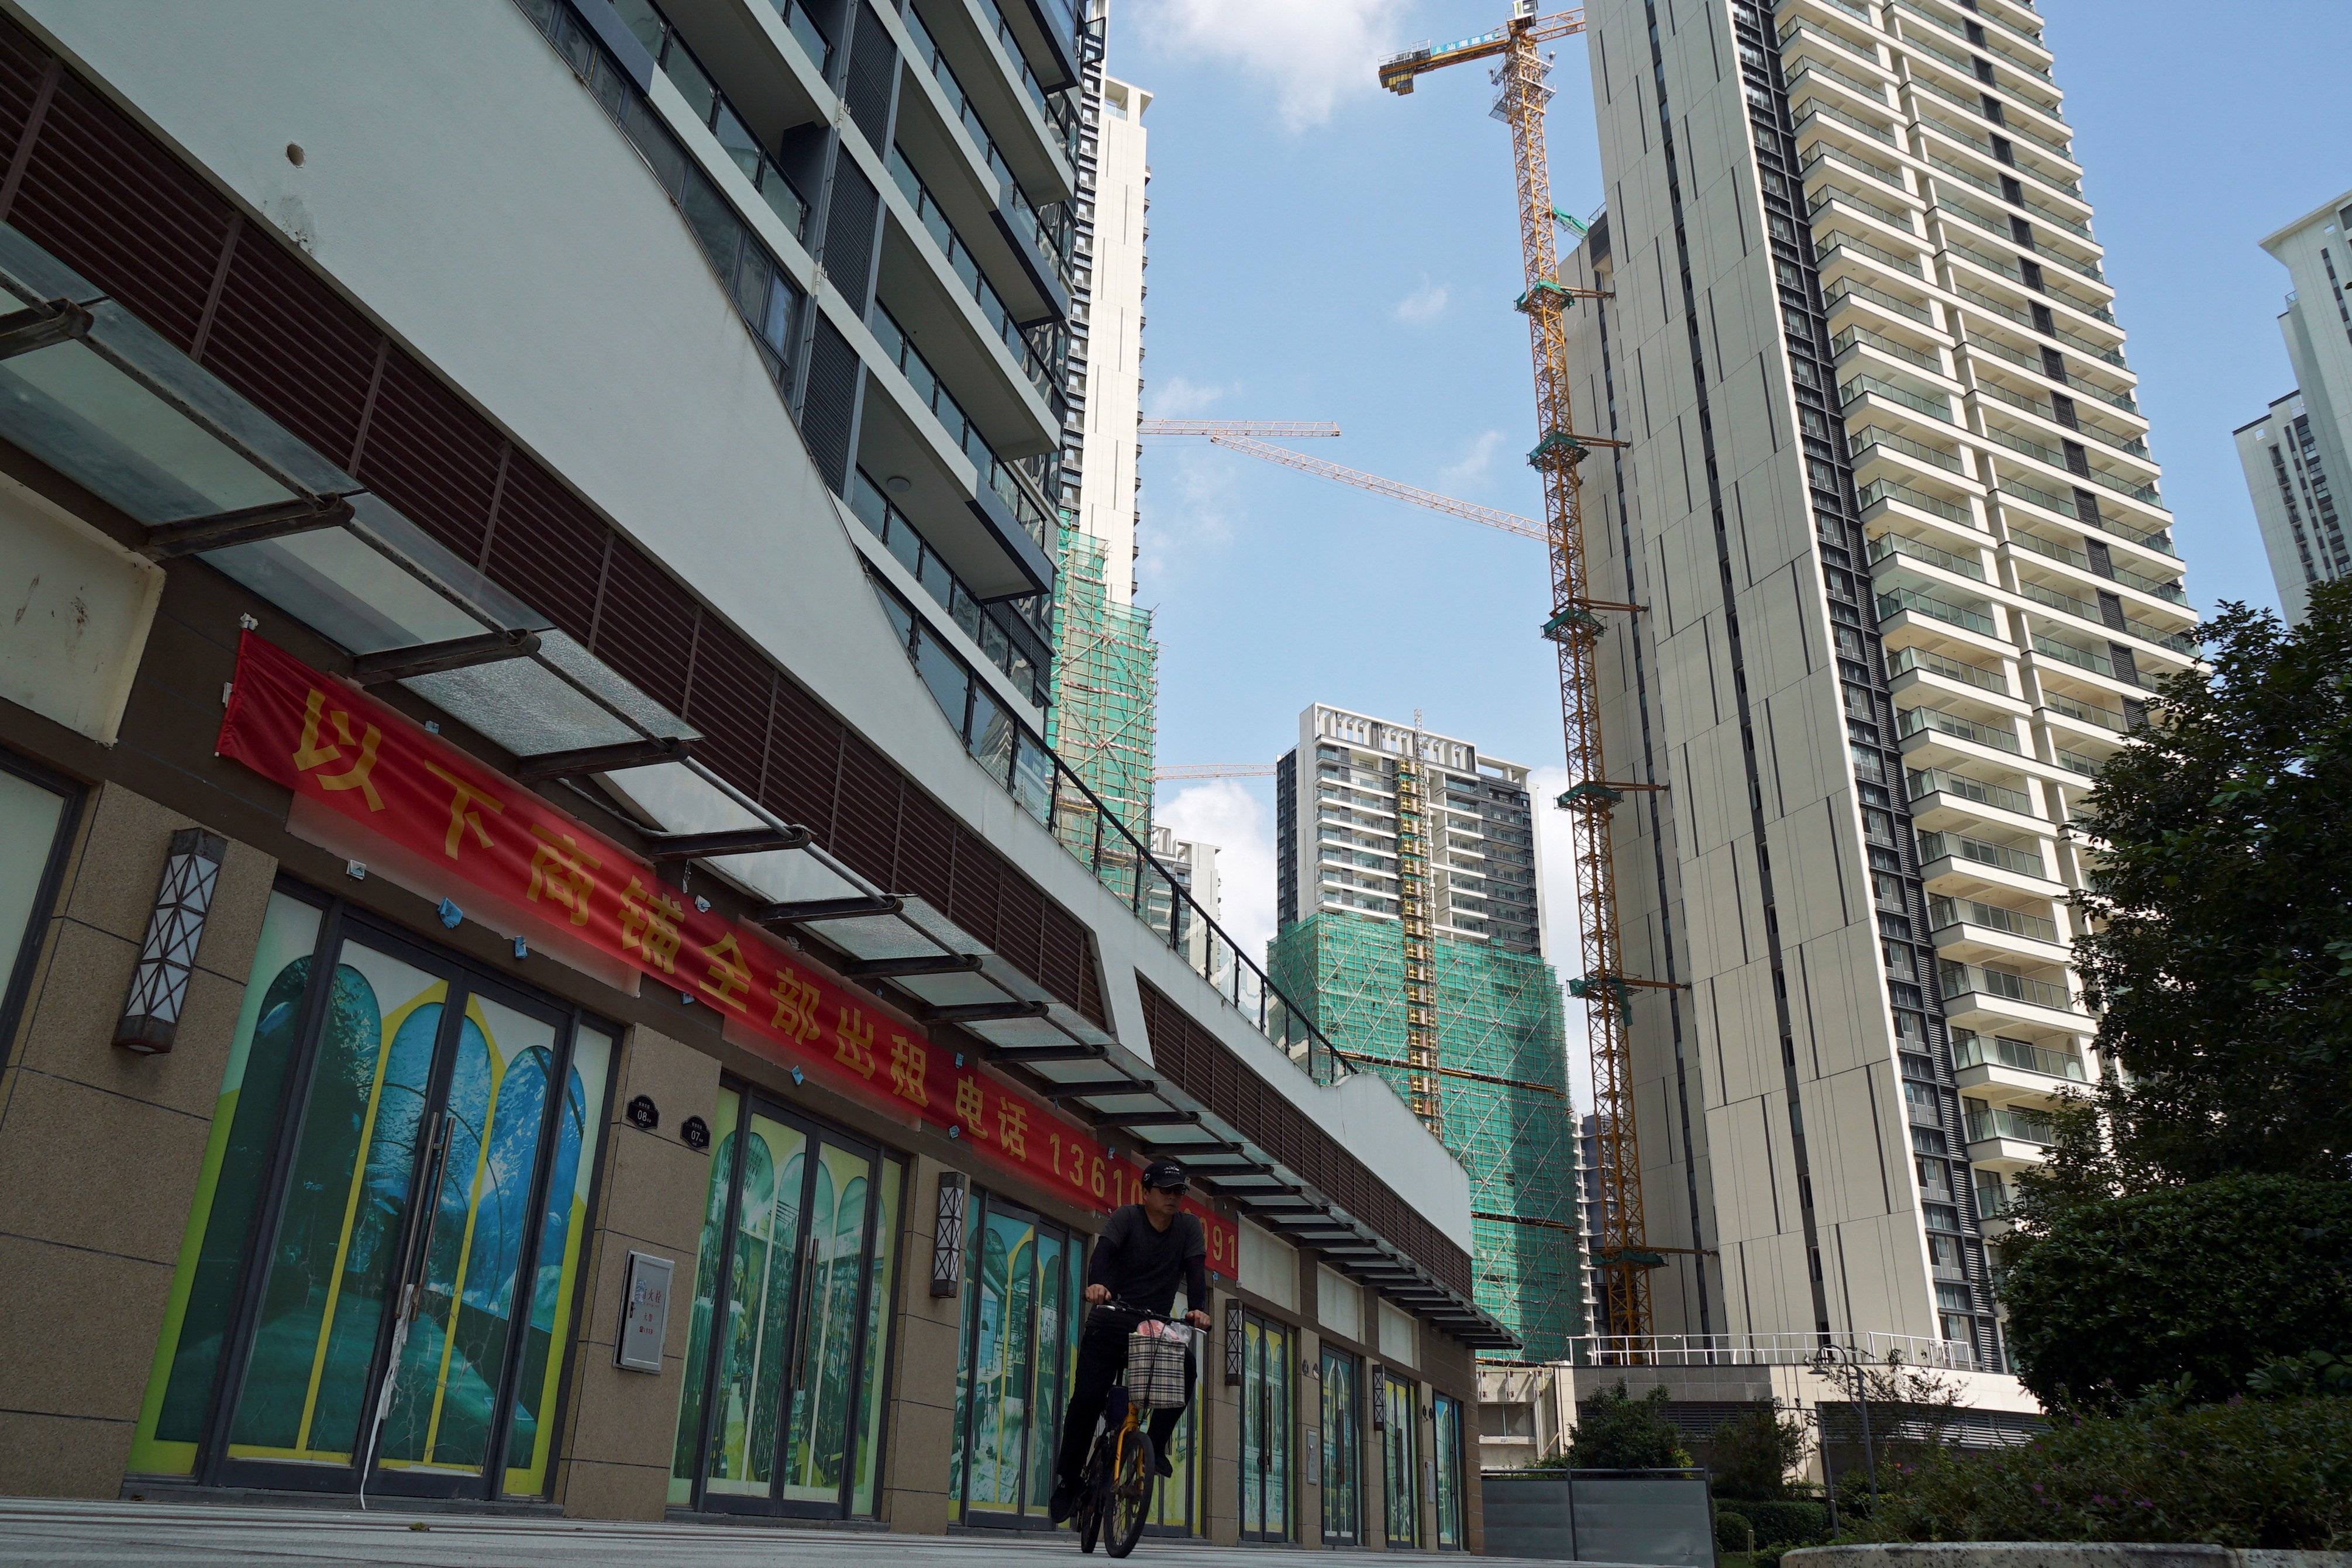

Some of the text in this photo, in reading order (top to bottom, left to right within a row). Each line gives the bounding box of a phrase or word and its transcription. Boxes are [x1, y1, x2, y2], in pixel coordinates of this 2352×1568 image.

[292, 688, 929, 1107] 以下商铺全部出租
[955, 1075, 1028, 1162] 电话
[637, 1110, 647, 1121] 08
[691, 1130, 700, 1141] 07
